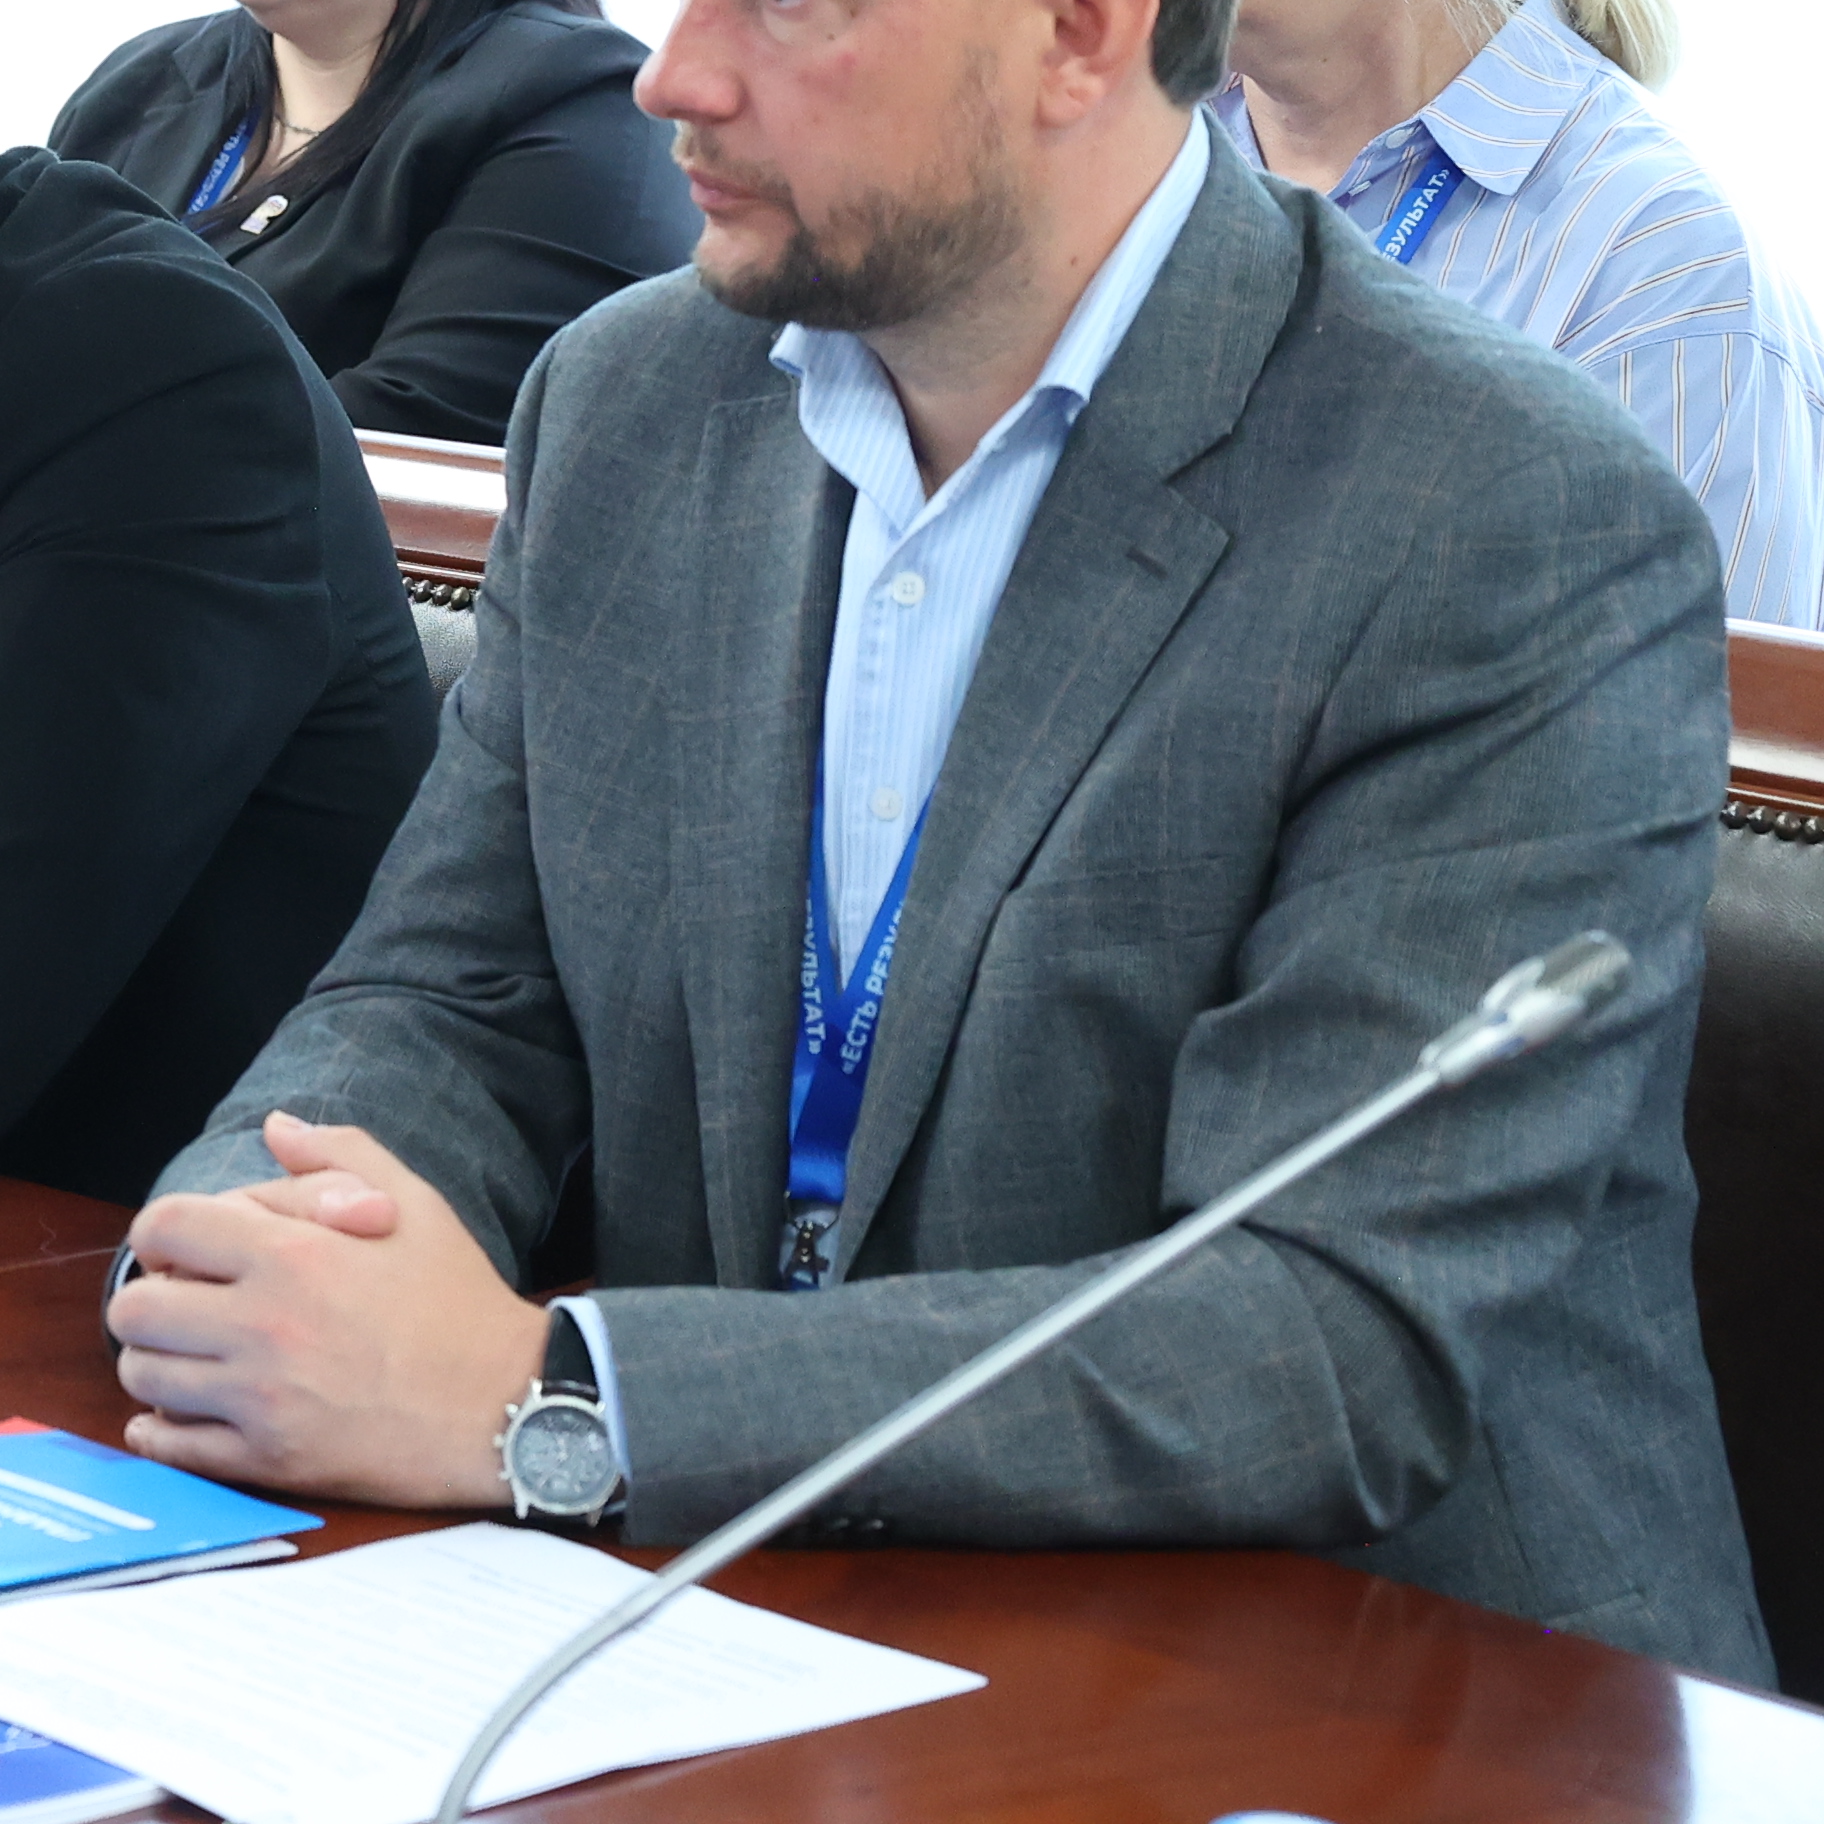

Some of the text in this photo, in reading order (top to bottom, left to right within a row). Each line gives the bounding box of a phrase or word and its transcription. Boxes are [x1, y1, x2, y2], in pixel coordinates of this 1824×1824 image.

[800, 899, 827, 1055] УЛЬТАТ»
[840, 900, 905, 1074] «ЕСТЬ РЕЗУ
